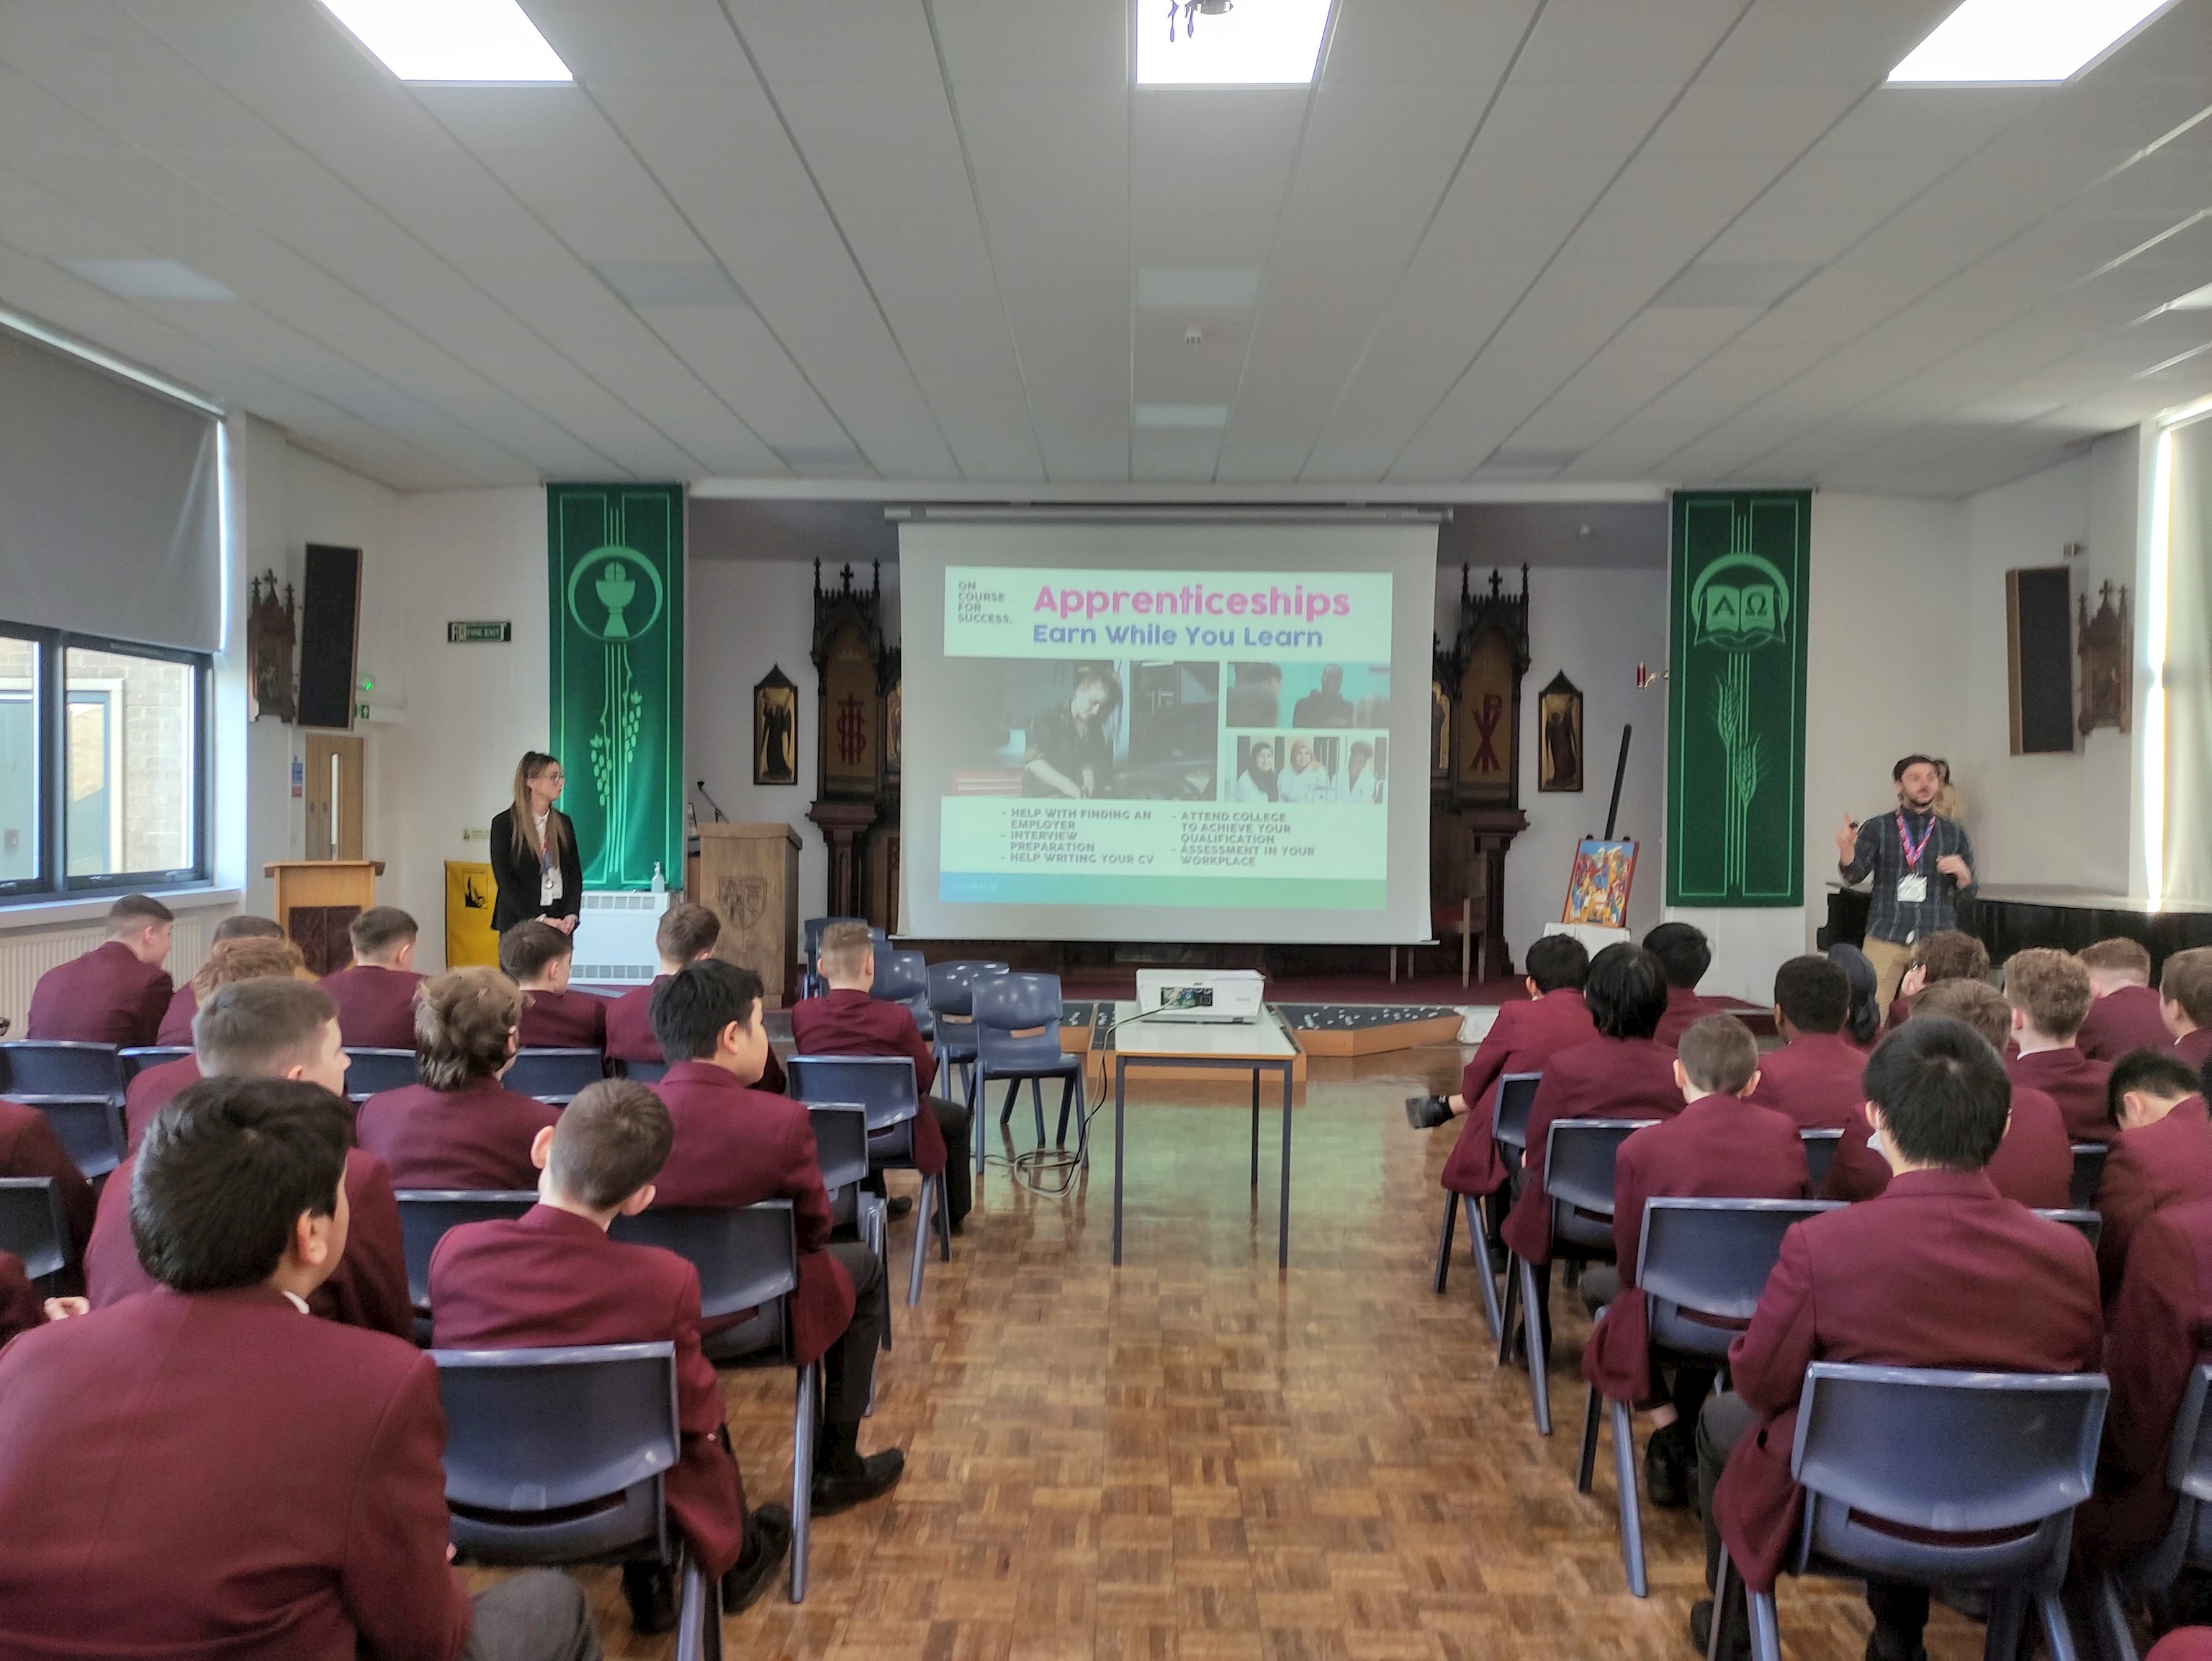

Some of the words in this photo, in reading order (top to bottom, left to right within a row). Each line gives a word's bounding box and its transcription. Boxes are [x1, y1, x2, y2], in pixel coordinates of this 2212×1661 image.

[958, 581, 976, 591] ON
[958, 593, 1005, 603] COURSE
[1033, 584, 1350, 623] Apprenticeships
[958, 603, 981, 613] FOR
[958, 613, 1013, 624] SUCCESS.
[1033, 624, 1096, 644] Earn
[1105, 624, 1177, 645] While
[1185, 626, 1234, 647] You
[1244, 627, 1323, 648] Learn
[1011, 808, 1041, 818] HELP
[1046, 809, 1076, 819] WITH
[1081, 809, 1130, 820] FINDING
[1133, 810, 1151, 820] AN
[1181, 811, 1229, 822] ATTEND
[1233, 812, 1287, 822] COLLEGE
[1011, 819, 1076, 829] EMPLOYER
[1181, 823, 1197, 832] TO
[1200, 823, 1253, 834] ACHIEVE
[1259, 824, 1291, 834] YOUR
[1010, 830, 1078, 841] INTERVIEW
[1180, 834, 1274, 845] QUALIFICATION
[1010, 842, 1095, 852] PREPARATION
[1180, 845, 1259, 855] ASSESSMENT
[1264, 845, 1277, 855] IN
[1282, 846, 1316, 857] YOUR
[1010, 852, 1040, 863] HELP
[1045, 853, 1096, 864] WRITING
[1101, 854, 1134, 864] YOUR
[1138, 855, 1154, 864] CV
[1180, 856, 1256, 866] WORKPLACE
